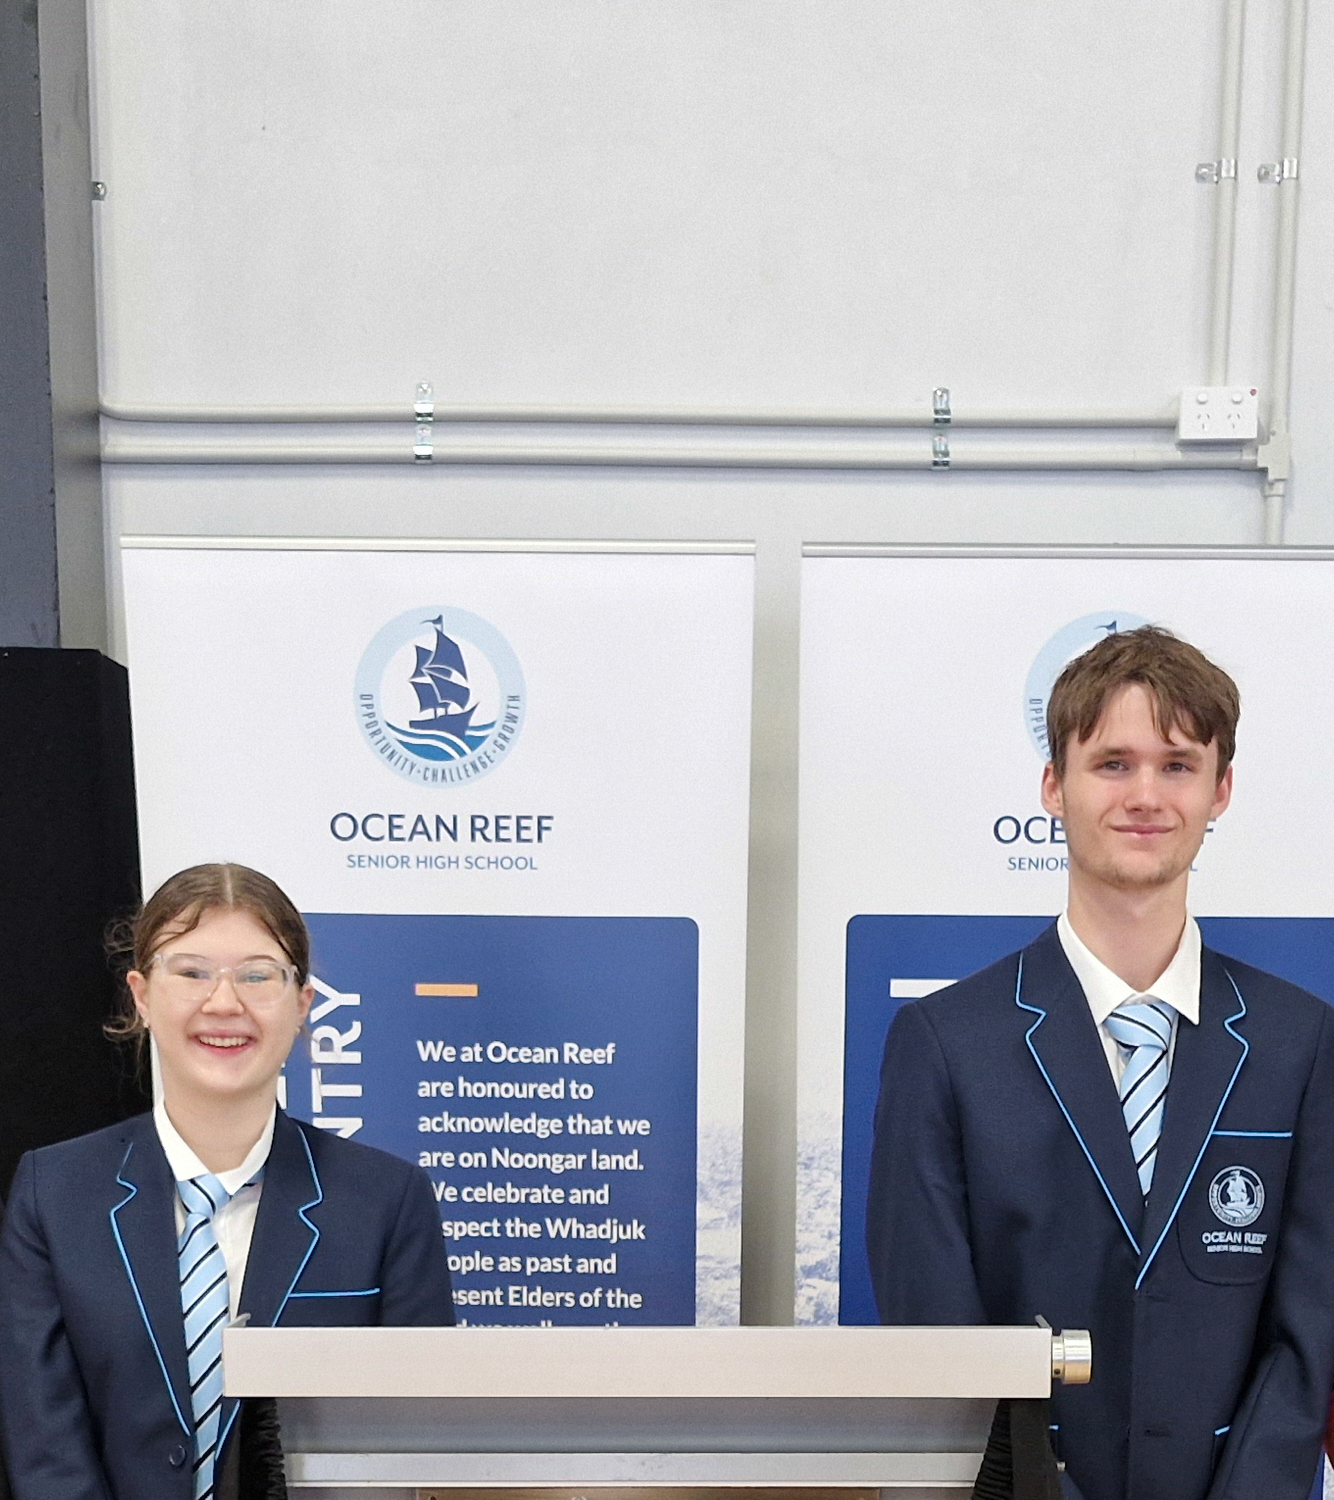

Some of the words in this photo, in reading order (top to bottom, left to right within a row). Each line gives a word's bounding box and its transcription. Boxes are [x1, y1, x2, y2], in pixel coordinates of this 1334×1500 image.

[330, 813, 457, 842] OCEAN
[471, 815, 553, 843] REEF
[993, 815, 1067, 844] OCE
[347, 855, 410, 869] SENIOR
[417, 856, 459, 869] HIGH
[465, 856, 537, 870] SCHOOL
[417, 1040, 456, 1062] We
[460, 1043, 482, 1062] at
[487, 1041, 558, 1063] Ocean
[564, 1043, 615, 1064] Reef
[418, 1081, 454, 1097] are
[459, 1076, 564, 1099] honoured
[569, 1080, 593, 1099] to
[418, 1112, 563, 1138] acknowledge
[567, 1114, 613, 1134] that
[617, 1120, 650, 1135] we
[419, 1151, 454, 1167] are
[459, 1152, 486, 1167] on
[492, 1148, 587, 1173] Noongar
[592, 1149, 643, 1170] land.
[462, 1182, 564, 1203] celebrate
[569, 1184, 608, 1204] and
[442, 1217, 501, 1240] spect
[505, 1217, 541, 1238] the
[545, 1218, 645, 1243] Whadjuk
[1202, 1232, 1241, 1244] OCEAN
[447, 1250, 495, 1276] ople
[498, 1257, 521, 1271] as
[526, 1254, 572, 1275] past
[576, 1253, 616, 1273] and
[509, 1286, 575, 1307] Elders
[579, 1287, 602, 1307] of
[606, 1288, 642, 1308] the
